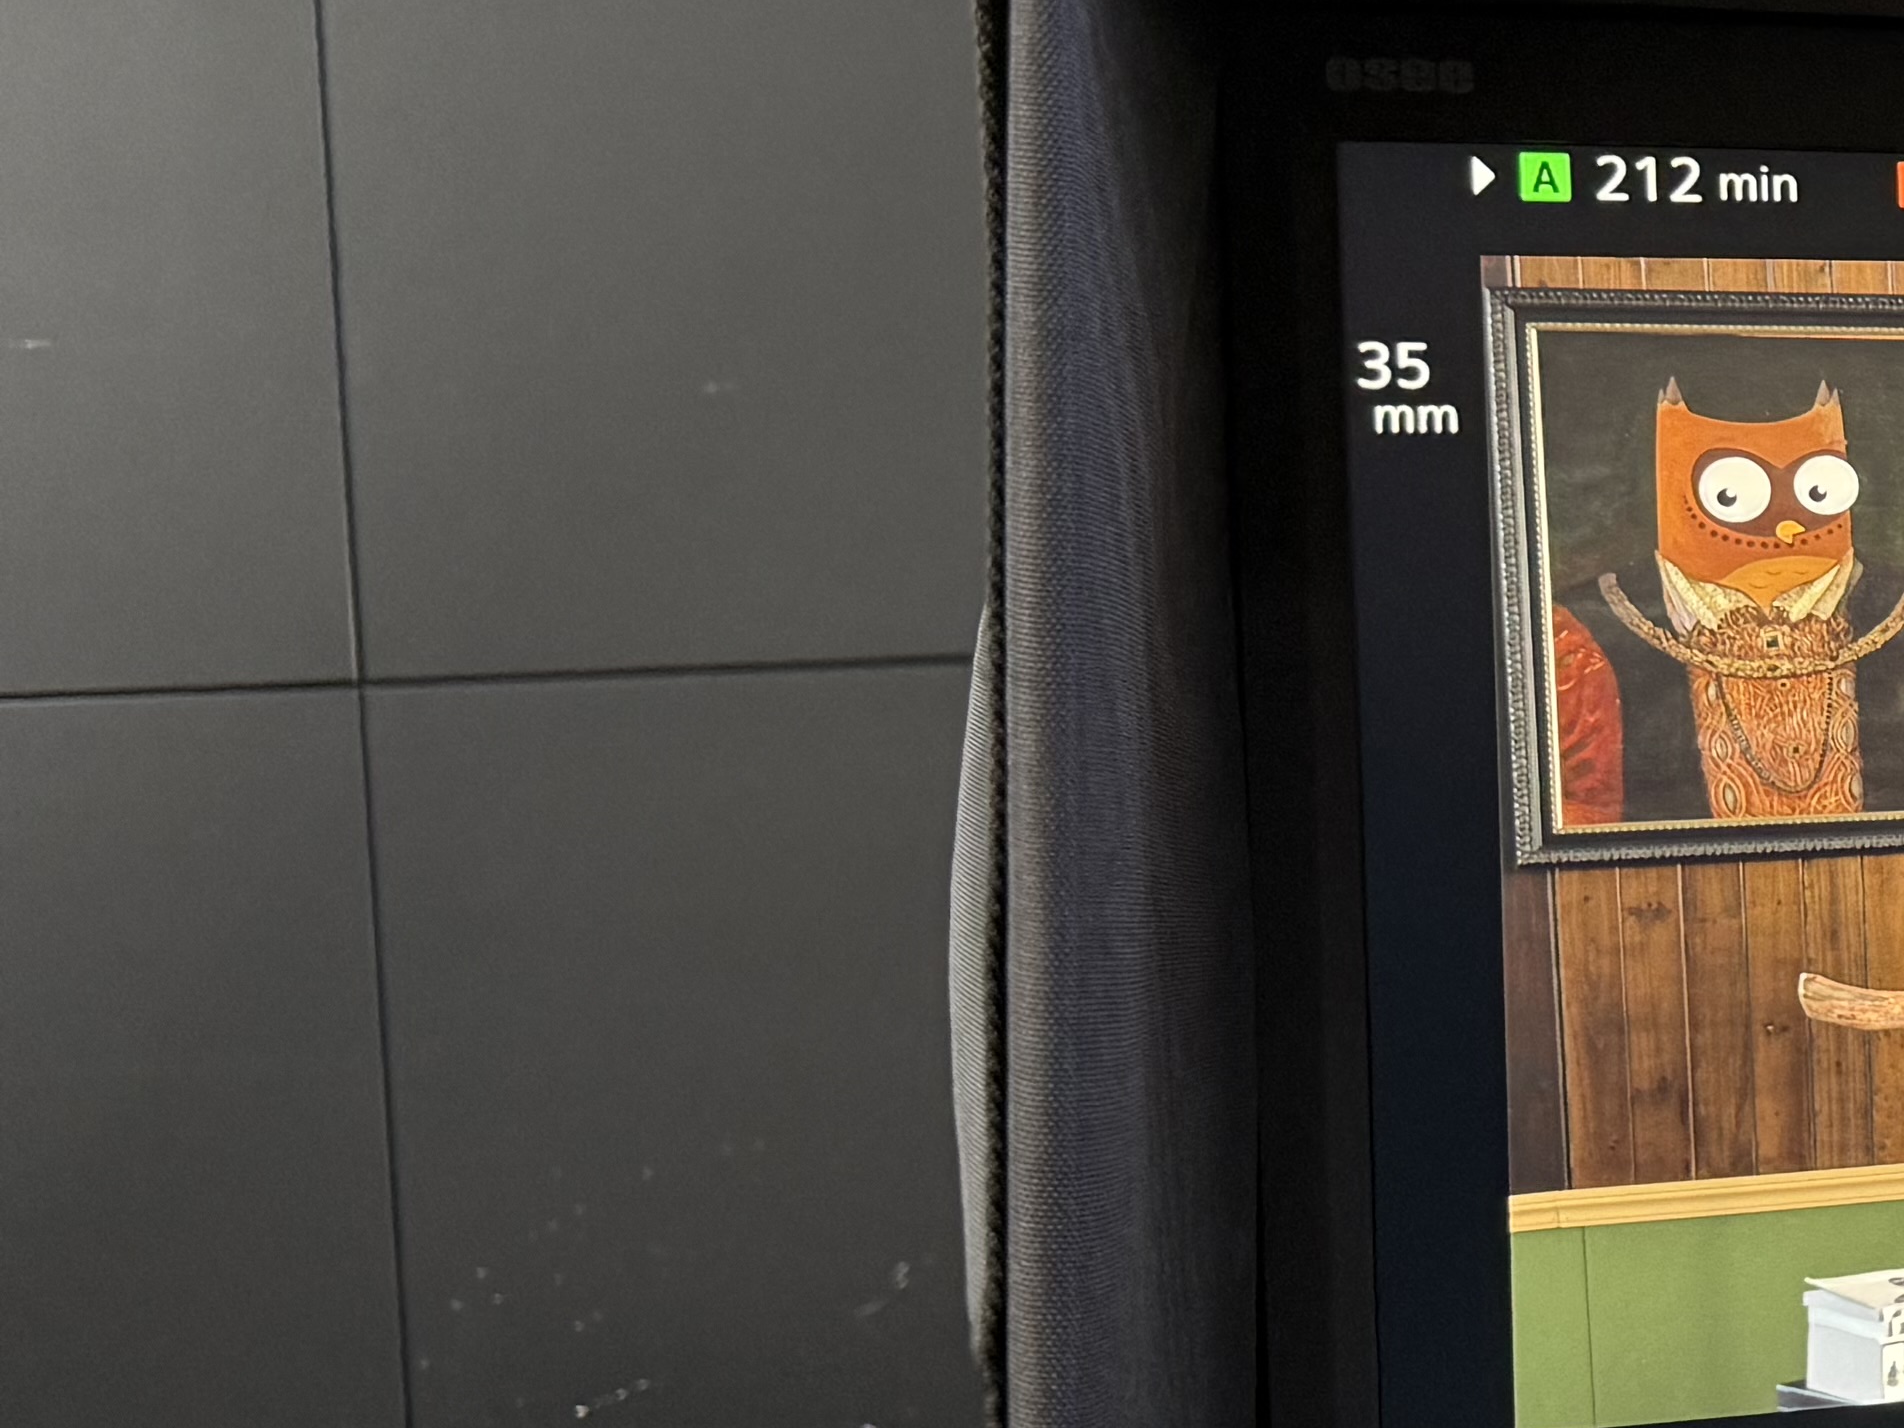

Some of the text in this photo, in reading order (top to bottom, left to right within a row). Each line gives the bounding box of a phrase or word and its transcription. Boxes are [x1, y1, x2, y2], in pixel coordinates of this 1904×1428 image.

[1532, 154, 1798, 204] A 212 min
[1355, 340, 1431, 391] 35
[1372, 403, 1460, 435] mm
